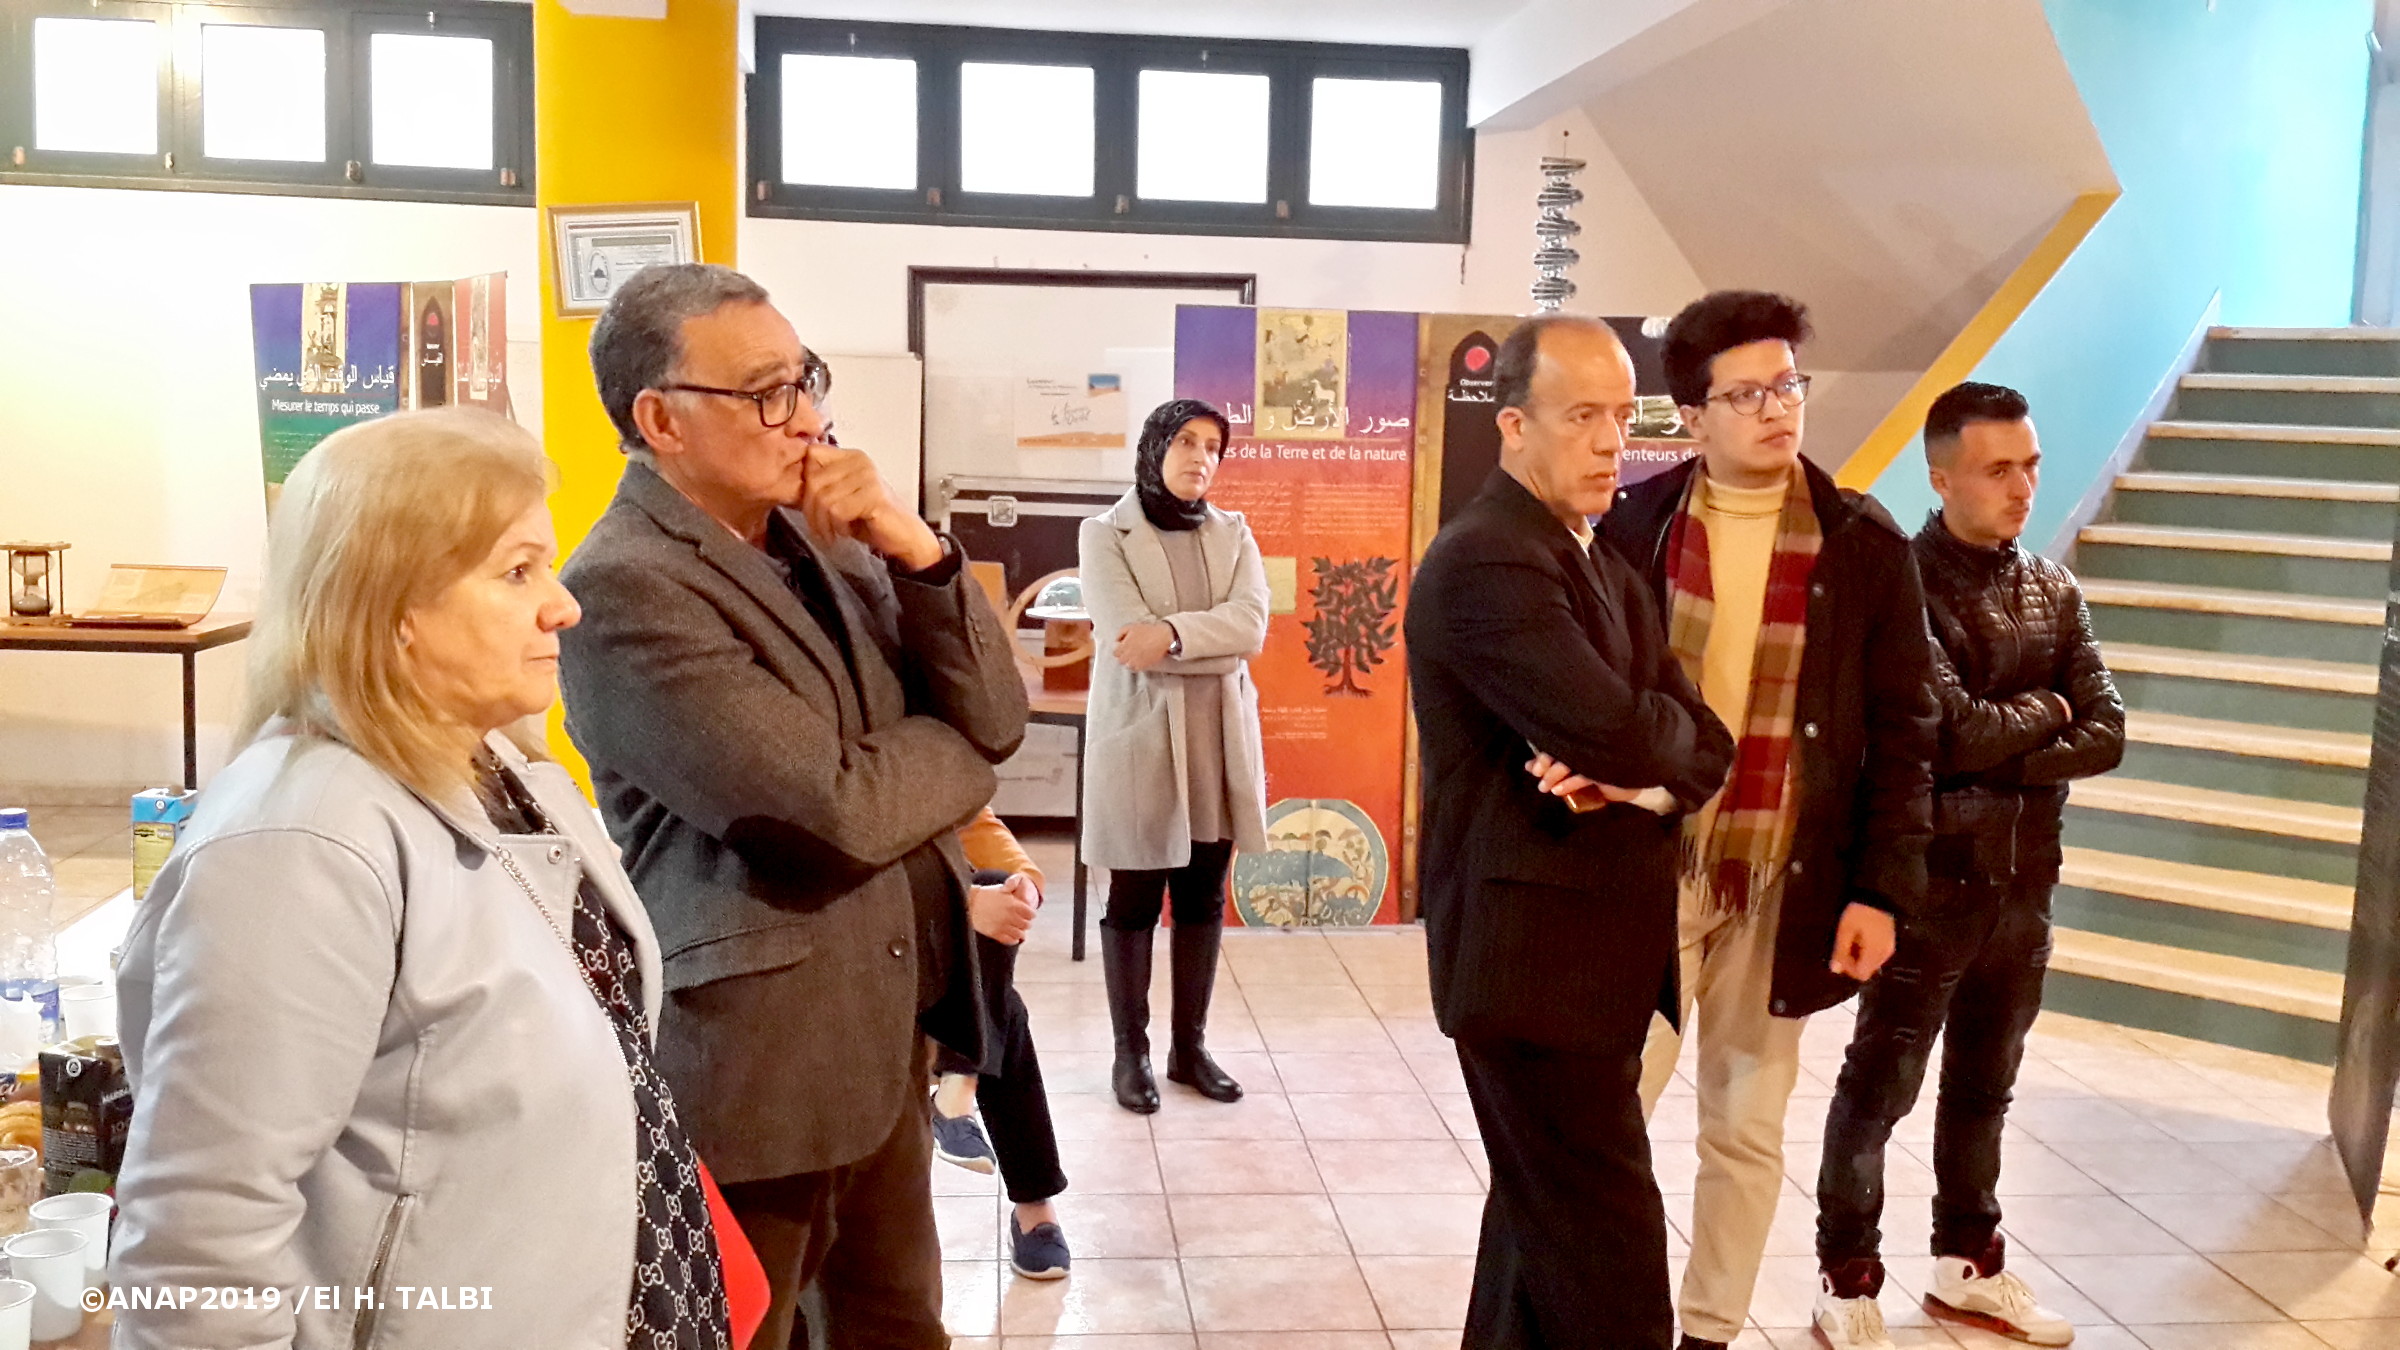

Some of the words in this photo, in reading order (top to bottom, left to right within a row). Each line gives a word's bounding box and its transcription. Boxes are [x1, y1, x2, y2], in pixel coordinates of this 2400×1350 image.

[260, 367, 294, 391] يمضي
[362, 364, 395, 389] قياس
[272, 399, 304, 412] Mesurer
[304, 399, 312, 413] le
[314, 401, 340, 416] temps
[341, 401, 354, 416] qui
[355, 403, 380, 416] passe
[1359, 415, 1410, 433] صور
[1240, 443, 1257, 459] de
[1260, 443, 1272, 459] la
[1276, 444, 1309, 460] Terre
[1312, 446, 1326, 460] et
[1329, 444, 1346, 460] de
[1349, 444, 1361, 460] la
[1364, 446, 1407, 461] nature
